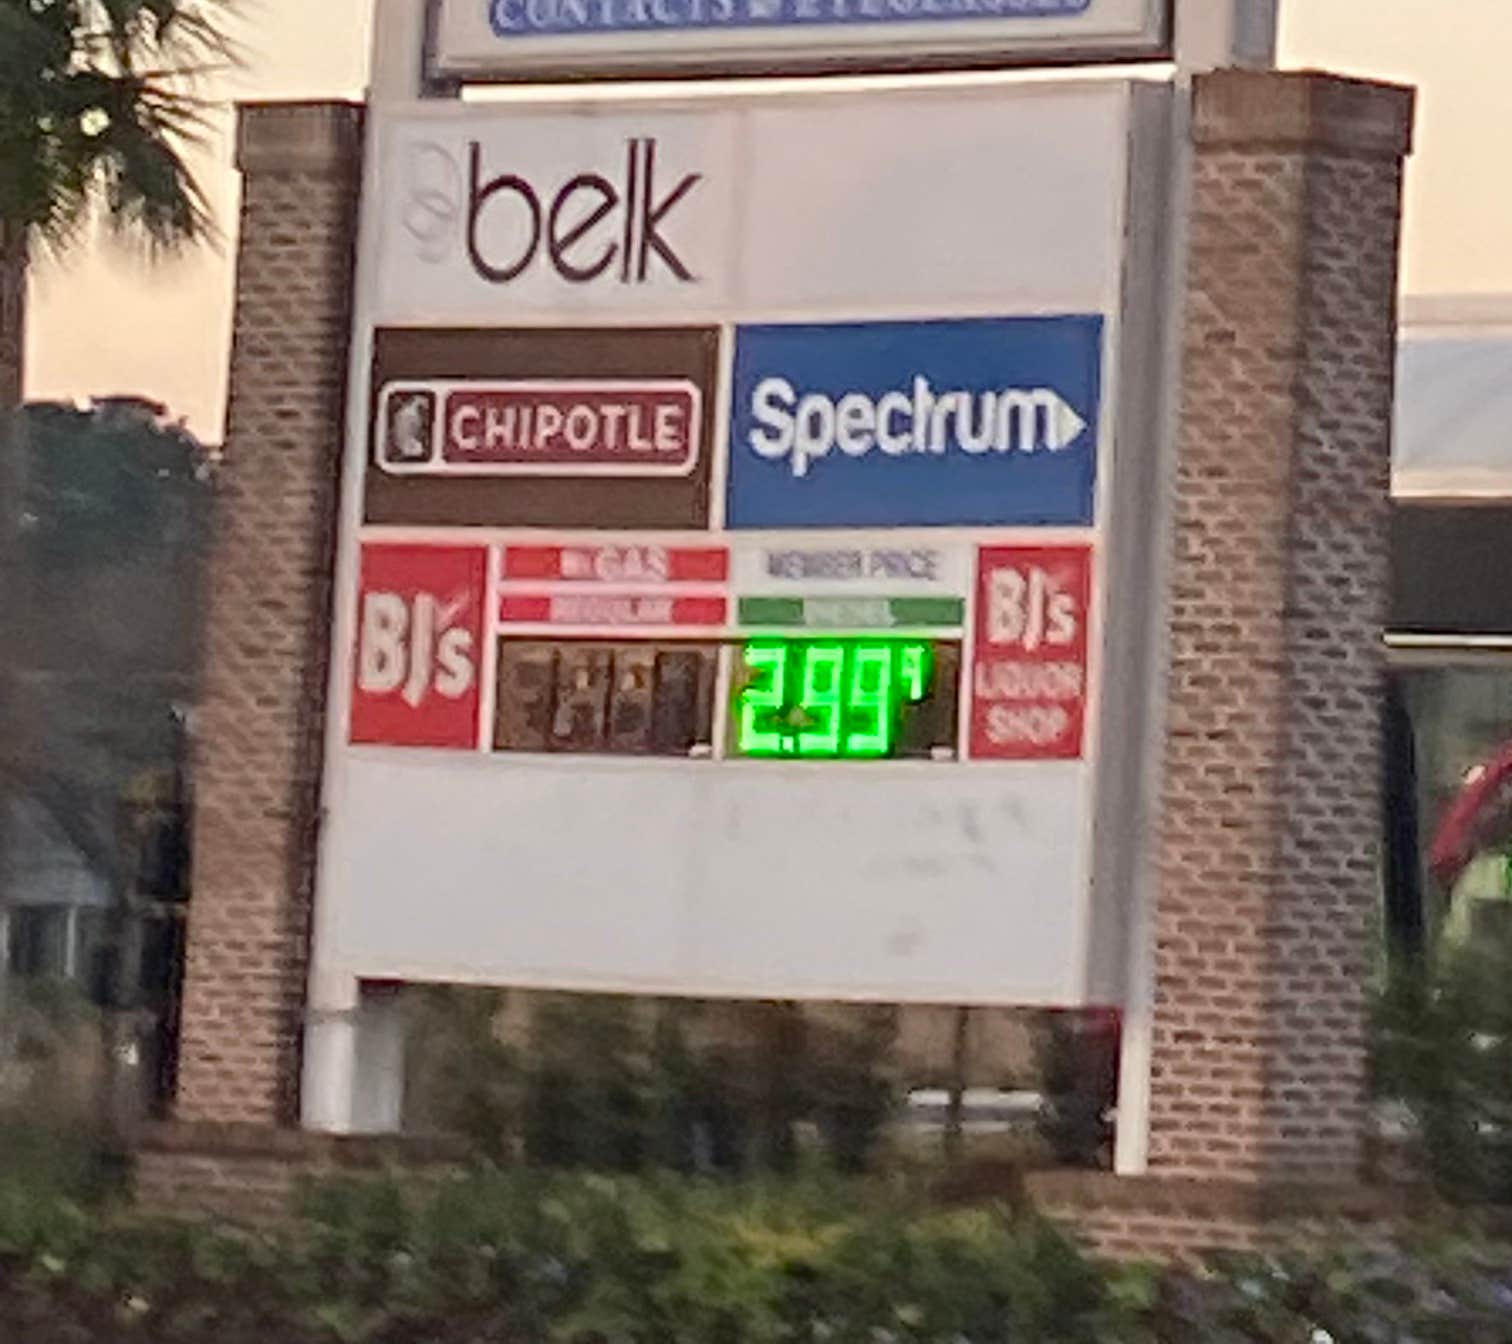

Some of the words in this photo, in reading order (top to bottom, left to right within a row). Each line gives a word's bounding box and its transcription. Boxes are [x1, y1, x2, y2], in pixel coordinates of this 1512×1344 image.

[466, 136, 704, 284] belk
[450, 402, 688, 454] CHIPOTLE
[748, 372, 1064, 476] Spectrum
[357, 586, 476, 708] BJ's
[985, 564, 1077, 652] BJ's
